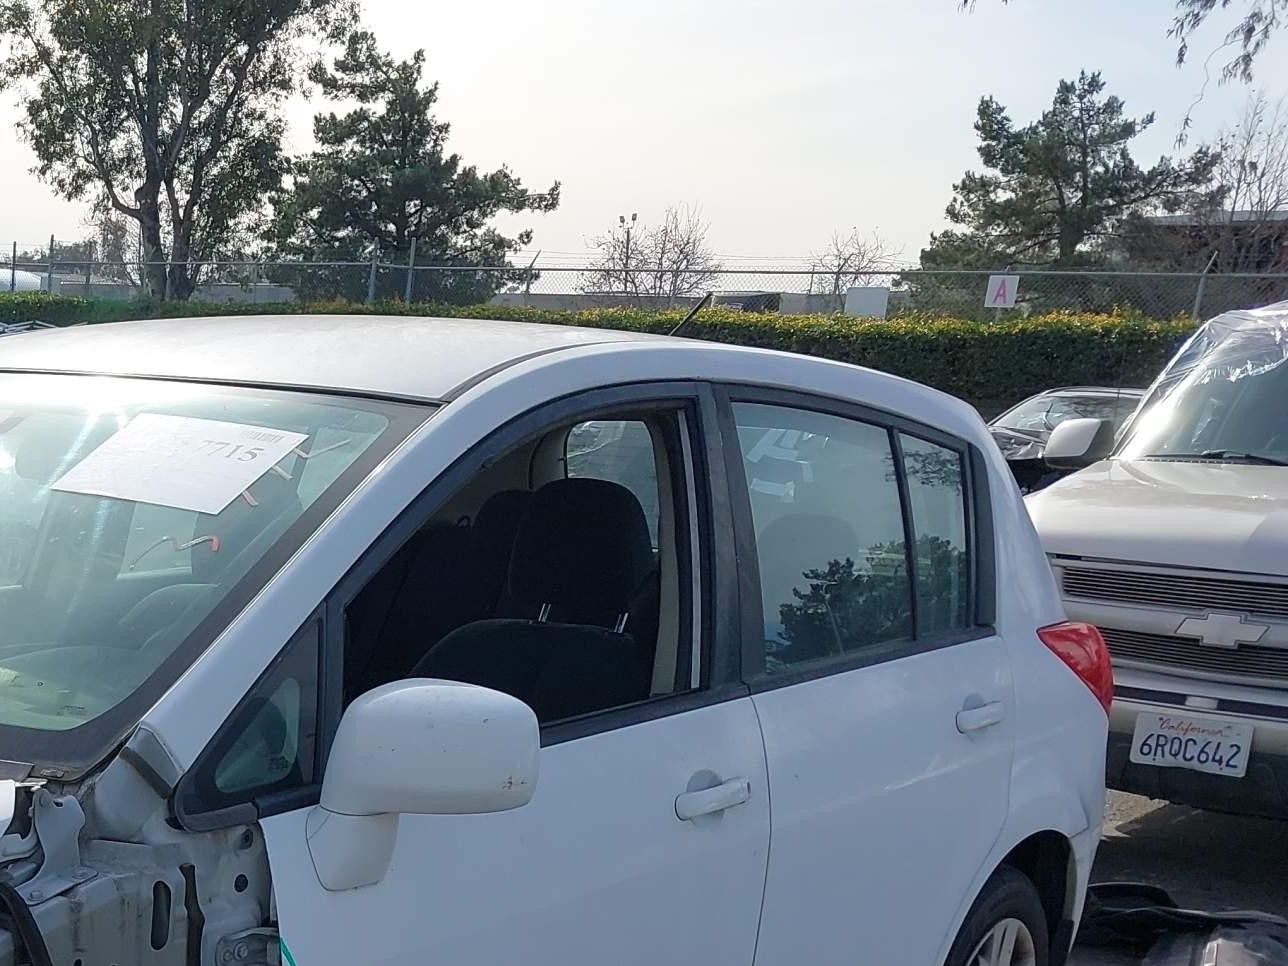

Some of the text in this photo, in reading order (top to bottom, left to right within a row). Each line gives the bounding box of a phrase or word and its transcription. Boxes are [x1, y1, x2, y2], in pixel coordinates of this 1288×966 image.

[992, 279, 1007, 304] A
[1159, 718, 1224, 737] California
[1139, 733, 1242, 769] 6RQC642
